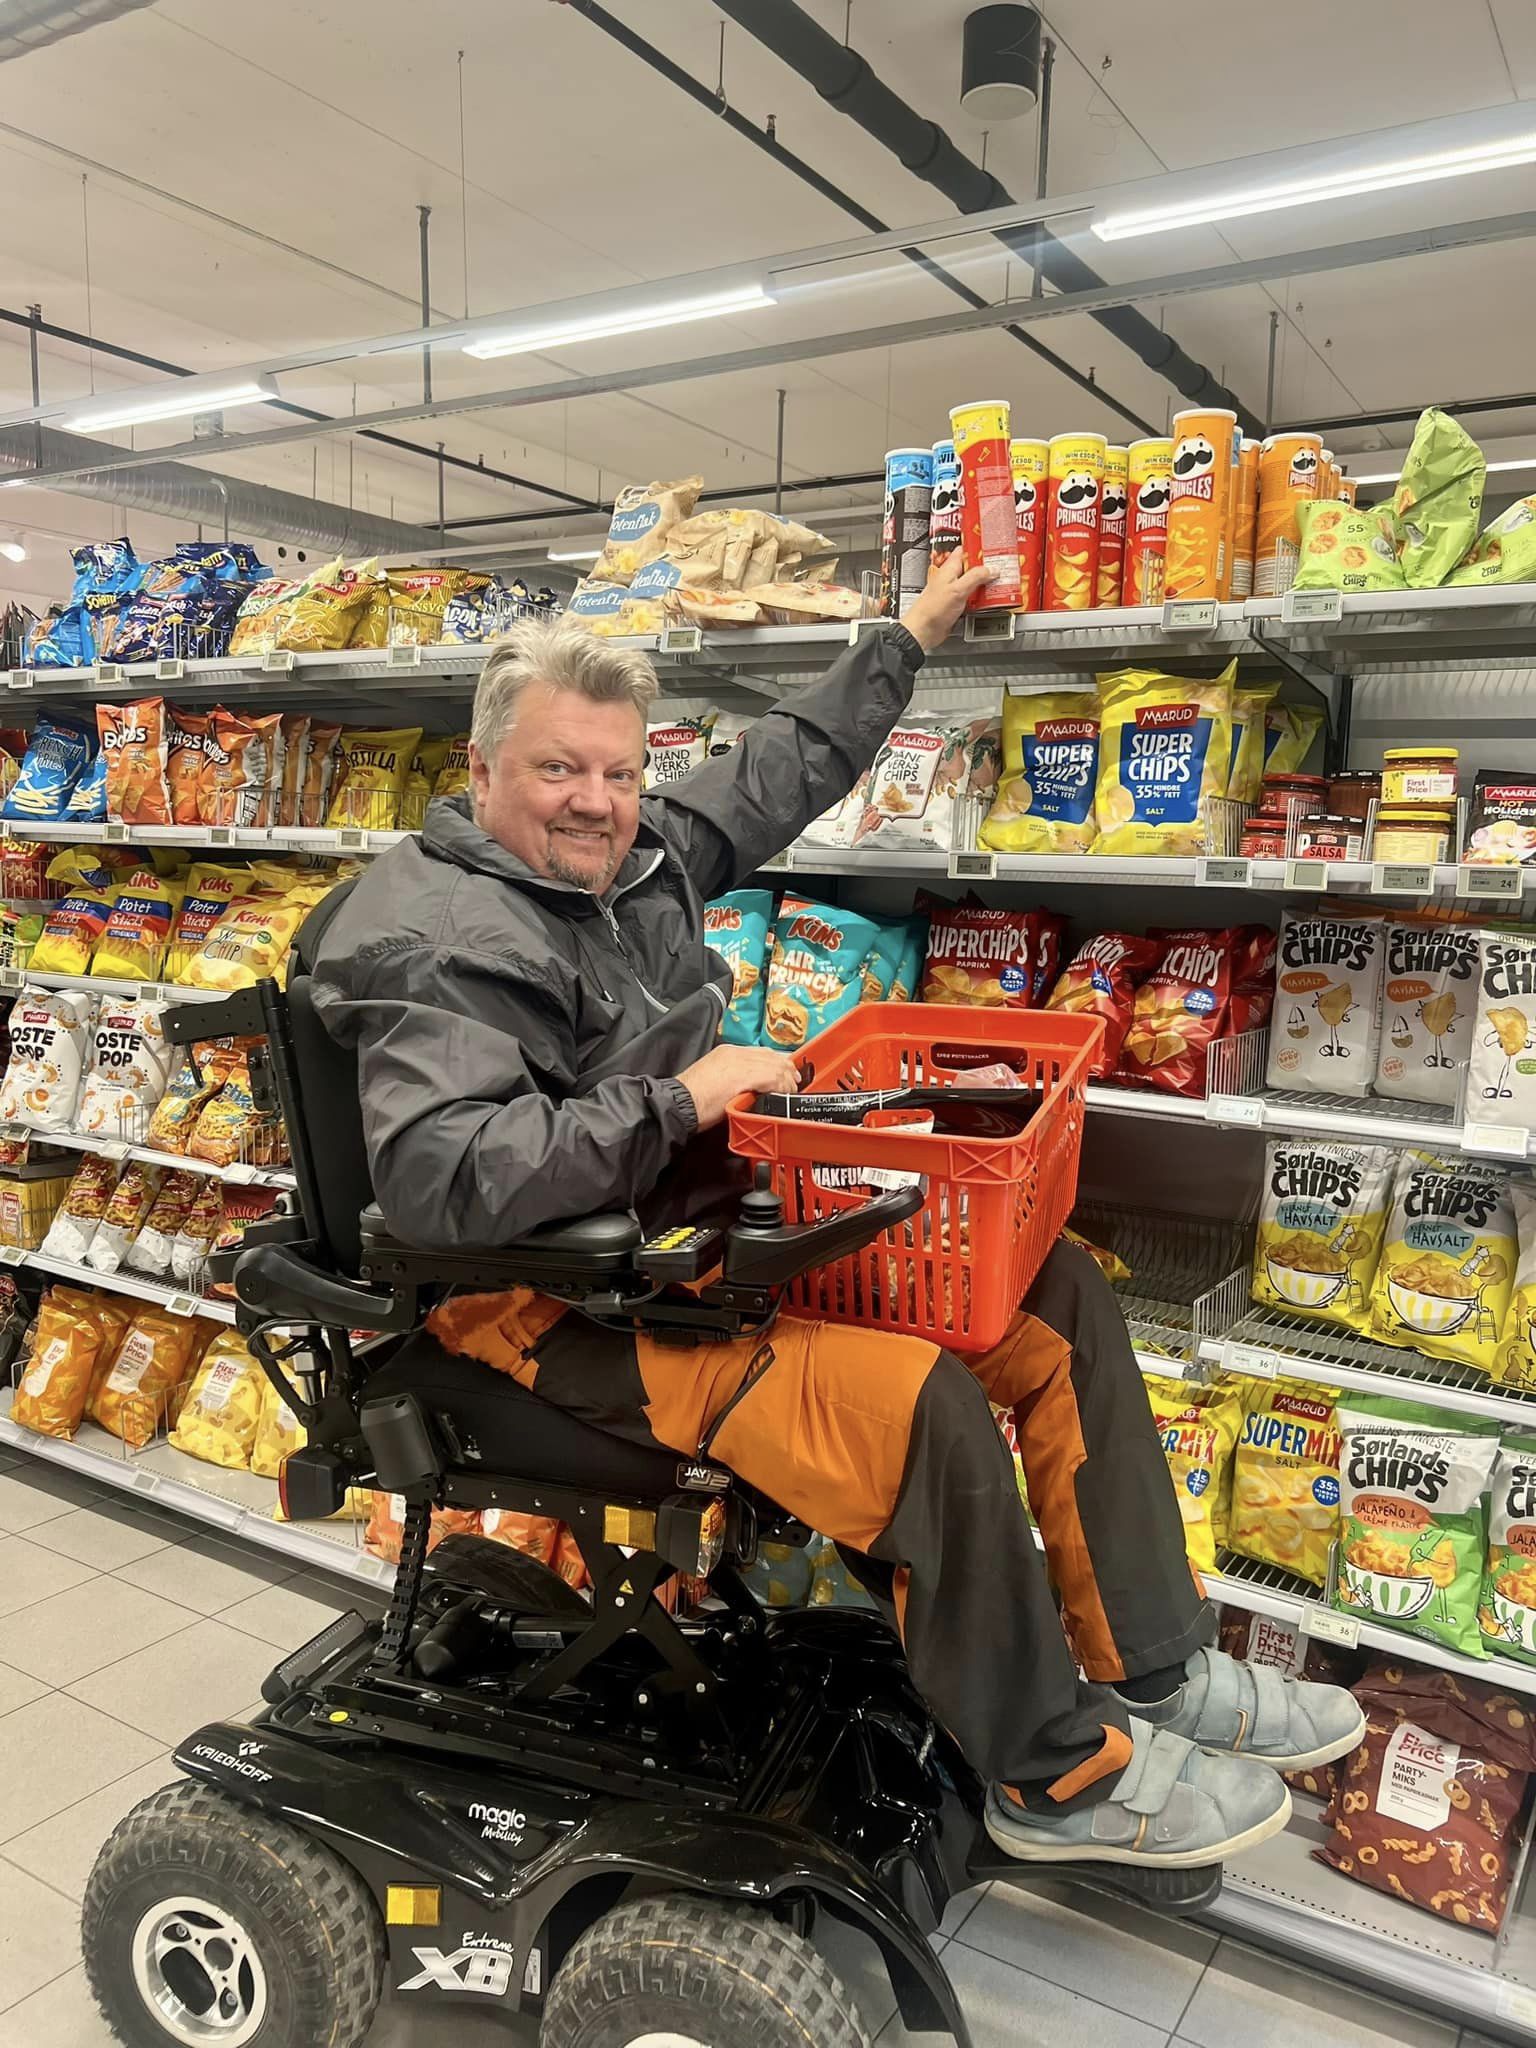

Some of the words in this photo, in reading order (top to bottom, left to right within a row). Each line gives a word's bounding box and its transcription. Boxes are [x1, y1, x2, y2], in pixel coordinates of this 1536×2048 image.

[1055, 507, 1097, 529] PRINGLES
[1140, 708, 1193, 726] MAARUD
[652, 731, 693, 745] MAARUD
[1040, 722, 1094, 739] MAARUD
[892, 735, 938, 750] MAARUD
[1130, 733, 1194, 758] SUPER
[1033, 744, 1095, 768] SUPER
[654, 760, 690, 772] VERKS
[883, 769, 919, 782] CHIPS
[1406, 778, 1425, 787] First
[1034, 780, 1052, 796] 35
[1135, 784, 1152, 799] 35
[1153, 784, 1181, 792] MINDRE
[1406, 786, 1428, 794] Price
[1041, 803, 1061, 813] SALT
[1145, 807, 1165, 815] SALT
[1499, 800, 1524, 808] HOT
[1254, 842, 1278, 854] SALSA
[1309, 846, 1342, 859] SALSA
[1232, 870, 1243, 878] 39
[1500, 879, 1512, 889] 24
[119, 899, 152, 914] Potet
[188, 899, 220, 915] Potet
[111, 913, 145, 928] Sticks
[182, 913, 212, 929] Sticks
[1284, 919, 1376, 945] Sørlands
[1390, 927, 1480, 953] Sørlands
[783, 949, 816, 972] AIR
[1281, 936, 1375, 972] CHIPS
[1387, 945, 1479, 980] CHIPS
[956, 960, 991, 969] PAPRIKA
[768, 961, 840, 994] CRUNCH
[11, 1027, 56, 1046] OSTE
[96, 1032, 142, 1052] OSTE
[16, 1044, 45, 1062] POP
[99, 1050, 133, 1067] POP
[106, 1070, 121, 1081] XL
[1273, 1150, 1362, 1183] Sørlands
[1271, 1169, 1360, 1208] CHIPS
[1410, 1171, 1500, 1201] Sørlands
[1403, 1189, 1497, 1228] CHIPS
[1283, 1211, 1338, 1228] HAVSALT
[1412, 1231, 1471, 1248] HAVSALT
[129, 1336, 148, 1350] First
[125, 1346, 148, 1361] Price
[216, 1360, 238, 1375] First
[1275, 1397, 1328, 1417] MAARUD
[1356, 1423, 1402, 1438] VERDENS
[1275, 1456, 1302, 1470] SALT
[1351, 1435, 1450, 1477] Sørlands
[684, 1466, 707, 1479] JAY
[1348, 1456, 1449, 1504] CHIPS
[1356, 1501, 1407, 1519] JALAPEÑO
[1409, 1510, 1416, 1519] &
[1259, 1623, 1294, 1647] First
[1339, 1626, 1350, 1636] 36
[1256, 1636, 1297, 1660] Price
[191, 1743, 273, 1783] KRIEGHOFF
[1393, 1762, 1428, 1779] PARTY-
[1391, 1772, 1417, 1787] MIKS
[1391, 1781, 1403, 1791] MED
[468, 1803, 527, 1831] magic
[480, 1825, 524, 1847] Mobility
[462, 1931, 514, 1953] Extreme
[396, 1946, 514, 1997] X8
